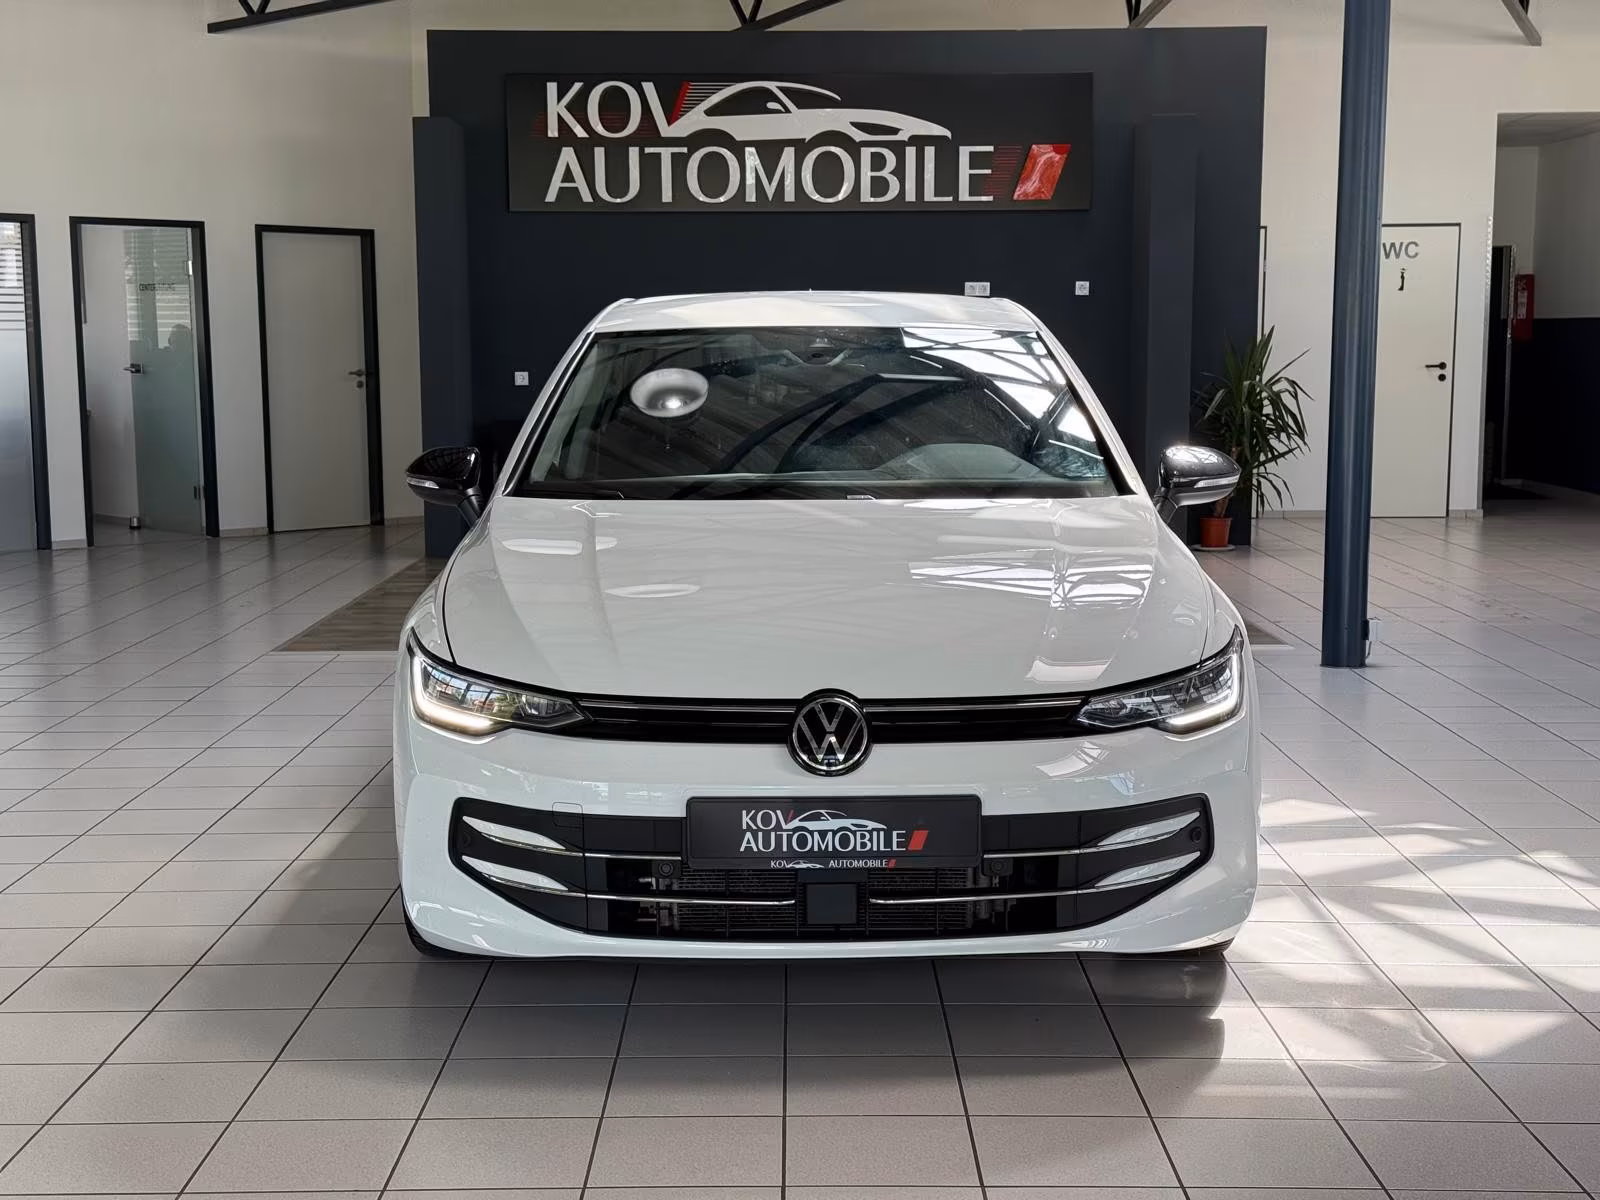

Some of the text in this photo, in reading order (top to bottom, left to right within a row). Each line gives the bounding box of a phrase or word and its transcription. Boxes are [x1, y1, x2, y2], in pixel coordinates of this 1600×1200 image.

[546, 80, 689, 138] KOV
[544, 145, 994, 203] AUTOMOBILE
[1382, 241, 1419, 259] WC
[741, 809, 794, 830] KOV
[739, 830, 906, 852] AUTOMOBILE
[770, 859, 888, 868] KOV AUTOMOBILE
